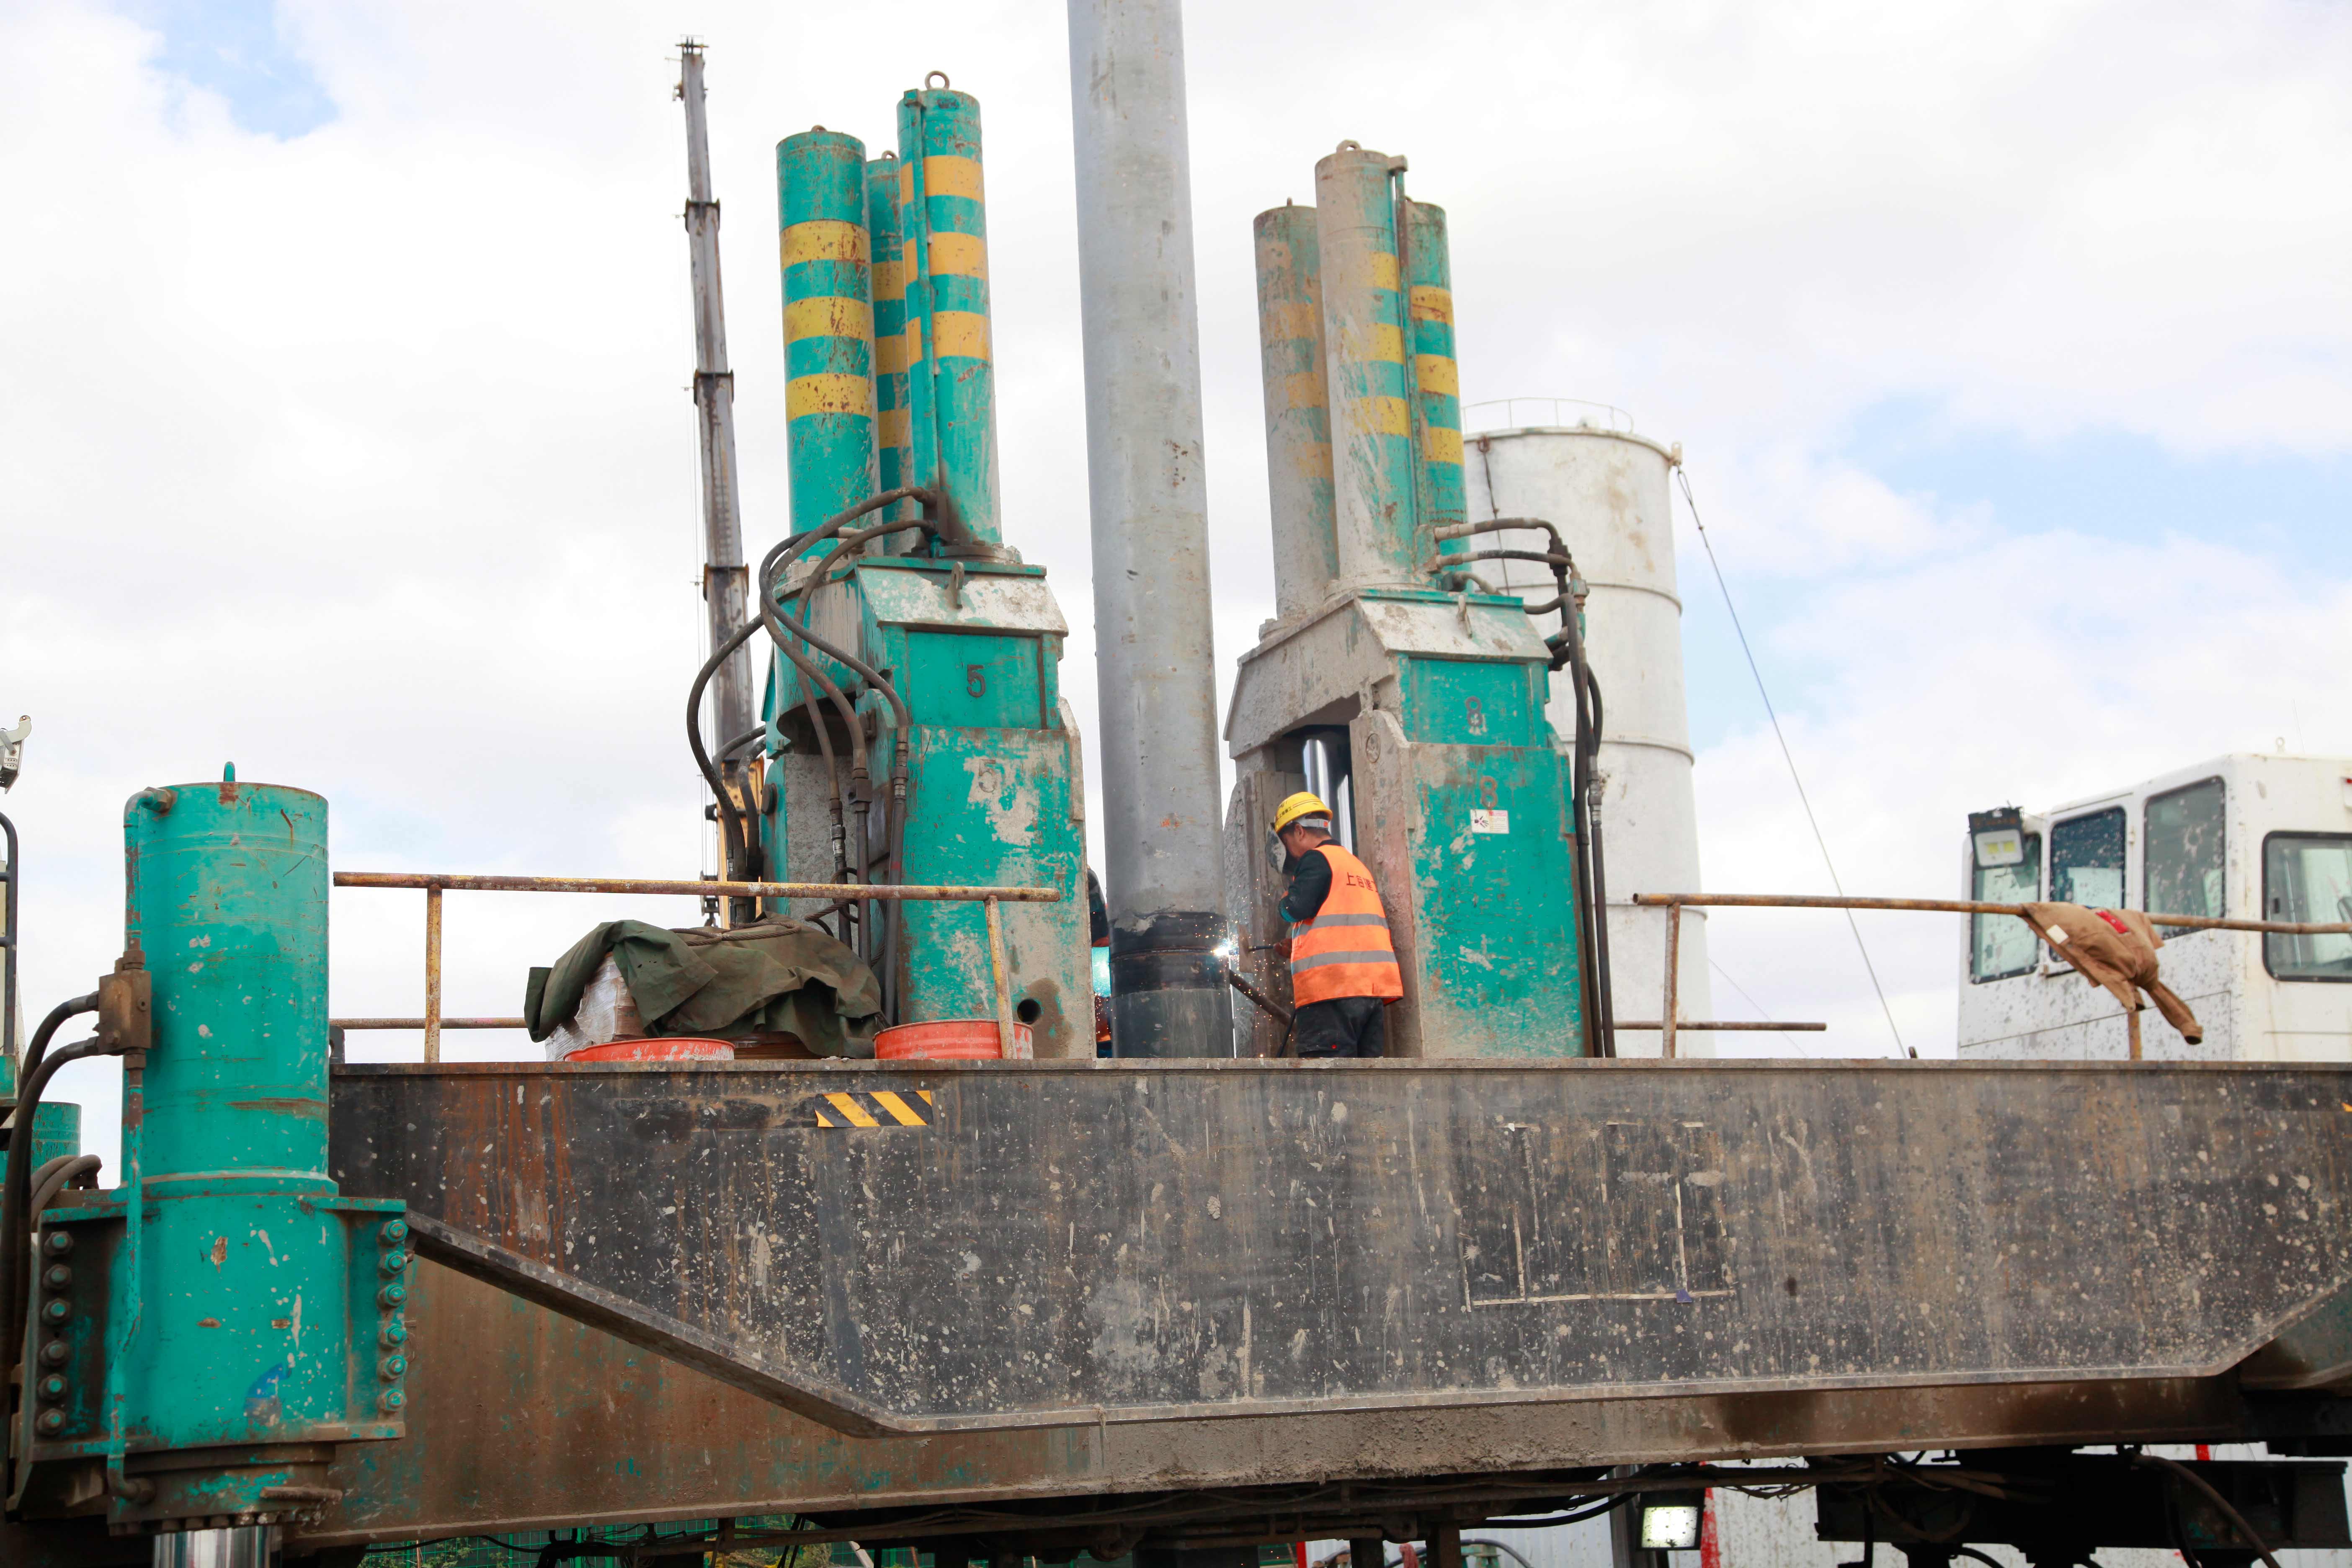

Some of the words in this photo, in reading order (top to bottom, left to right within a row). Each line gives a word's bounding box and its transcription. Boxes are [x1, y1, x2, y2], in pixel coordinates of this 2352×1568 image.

[967, 664, 986, 698] 5
[1465, 696, 1483, 727] 8
[978, 758, 998, 793] 5
[1480, 776, 1498, 809] 8
